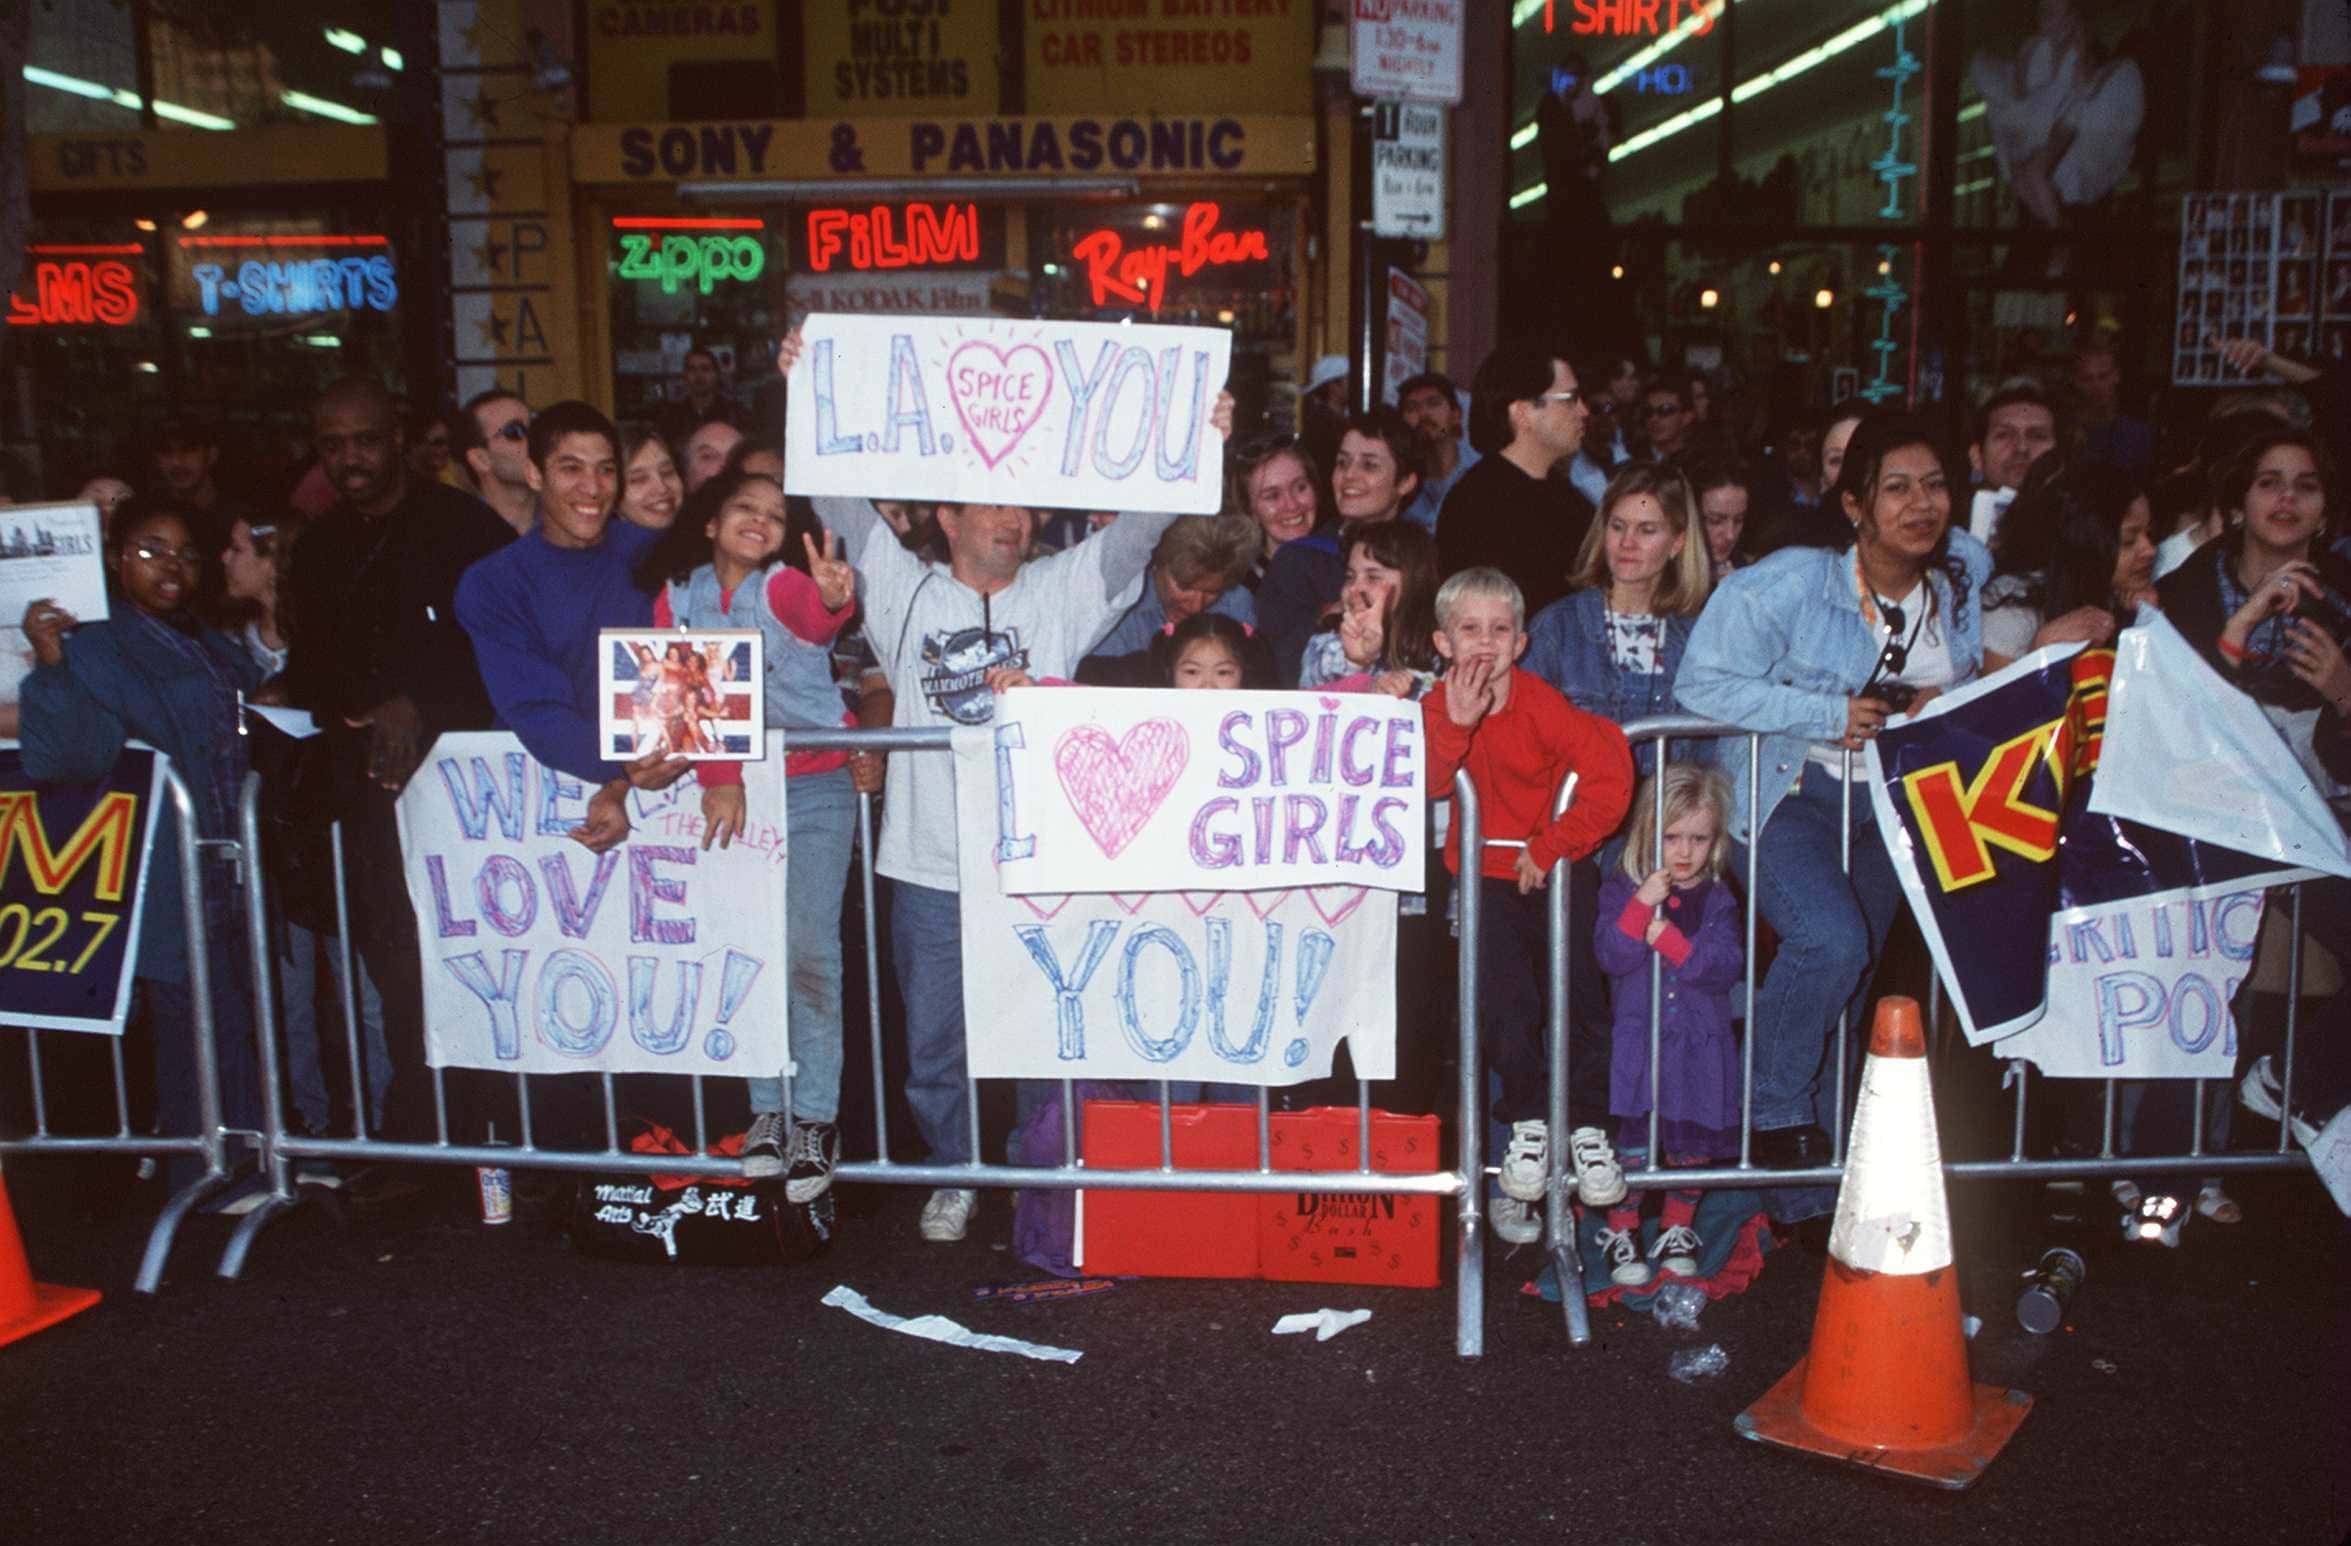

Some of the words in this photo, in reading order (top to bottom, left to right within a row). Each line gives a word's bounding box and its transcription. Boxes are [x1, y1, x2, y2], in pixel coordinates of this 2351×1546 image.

[851, 19, 940, 58] MULTI
[1041, 31, 1101, 65] CAR
[1115, 30, 1251, 65] STEREOS
[834, 57, 968, 98] SYSTEMS
[57, 140, 146, 177] GIFTS
[620, 125, 774, 177] SONY
[828, 124, 865, 173] &
[912, 119, 1246, 173] PANASONIC
[192, 254, 399, 317] T-SHIRTS
[1073, 201, 1269, 313] Ray-Ban
[831, 287, 927, 312] KODAK
[812, 334, 956, 457] L.A.
[1054, 337, 1210, 483] YOU
[957, 366, 1037, 402] SPICE
[967, 404, 1027, 435] GIRLS
[436, 750, 591, 843] WE
[993, 721, 1038, 868] I
[1217, 696, 1417, 791] SPICE
[1188, 793, 1410, 871] GIRLS
[424, 845, 697, 945] LOVE
[442, 947, 764, 1063] YOU!
[1012, 917, 1336, 1068] YOU!
